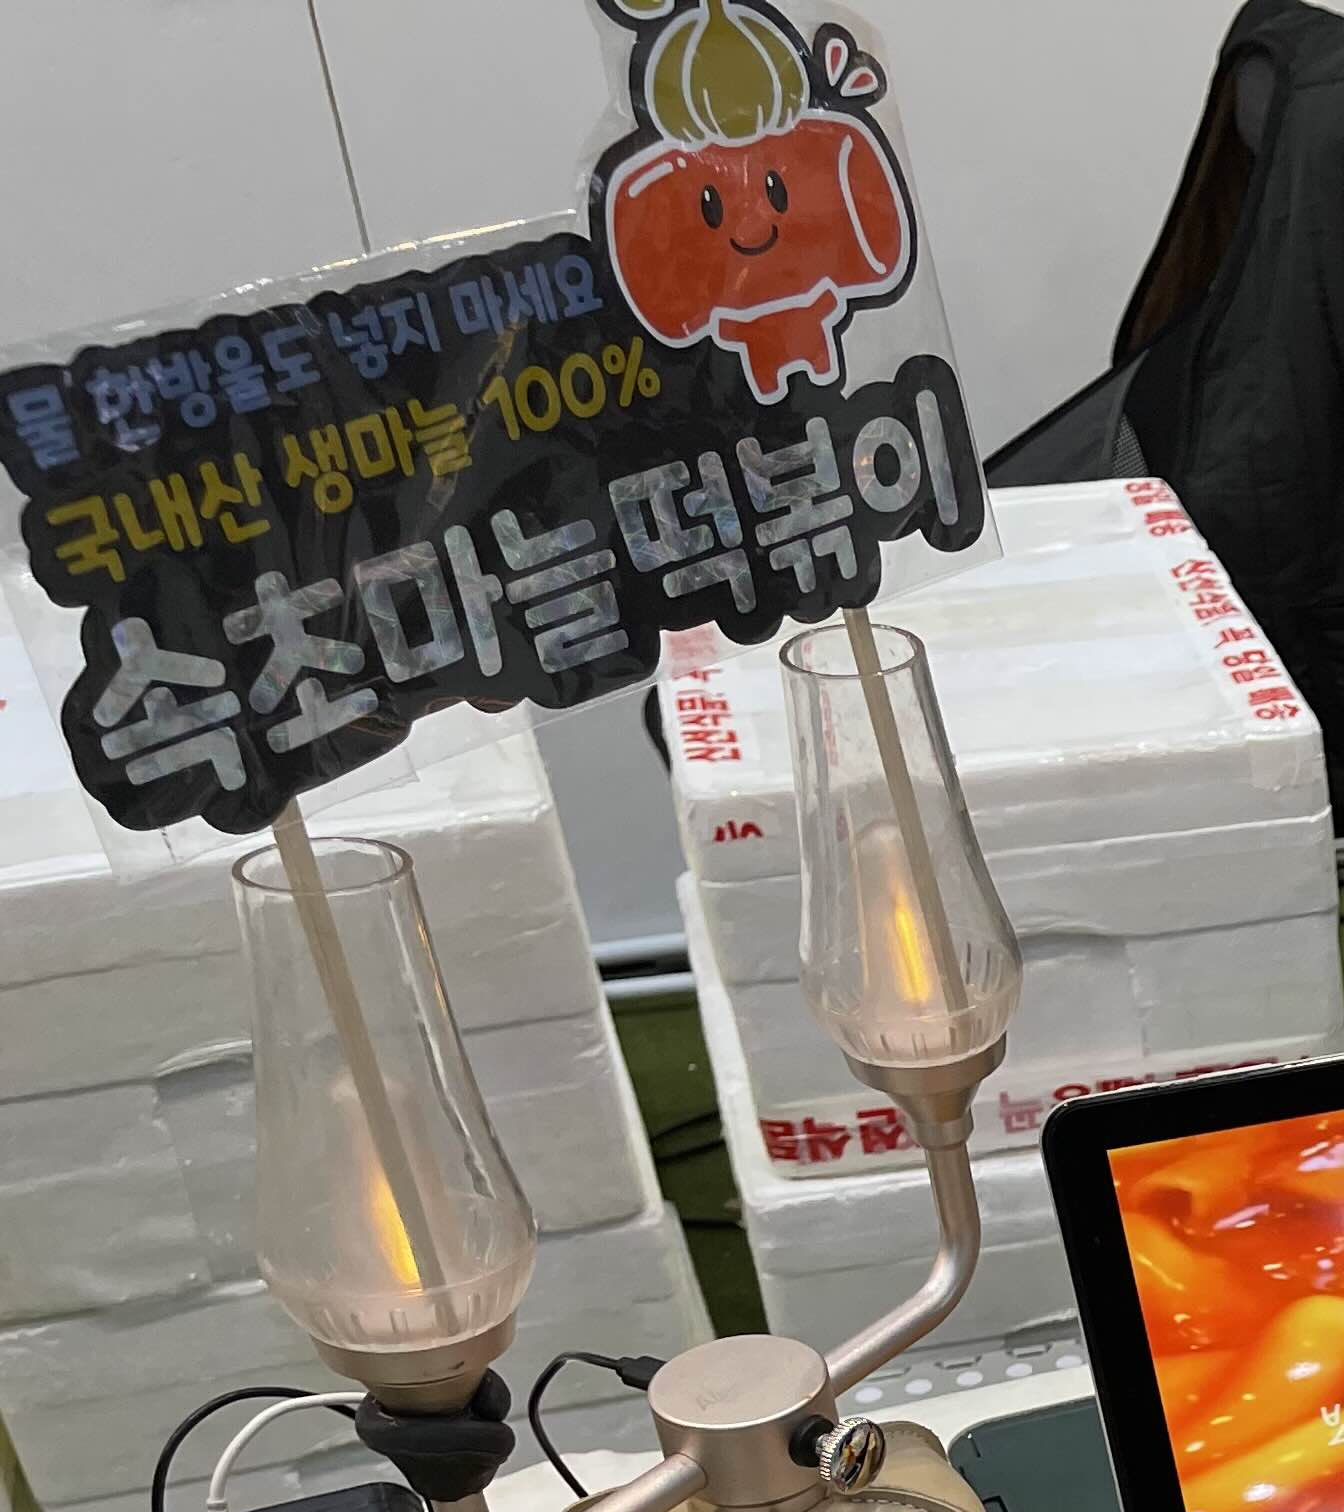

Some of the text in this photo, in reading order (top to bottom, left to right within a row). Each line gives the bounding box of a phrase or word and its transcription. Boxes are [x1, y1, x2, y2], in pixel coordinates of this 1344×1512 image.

[10, 254, 603, 472] 물 한방울도 넣지 마세요
[47, 335, 661, 583] 국내산 생마늘 100%
[93, 509, 629, 792] 속초마늘
[608, 388, 960, 614] 떡볶이
